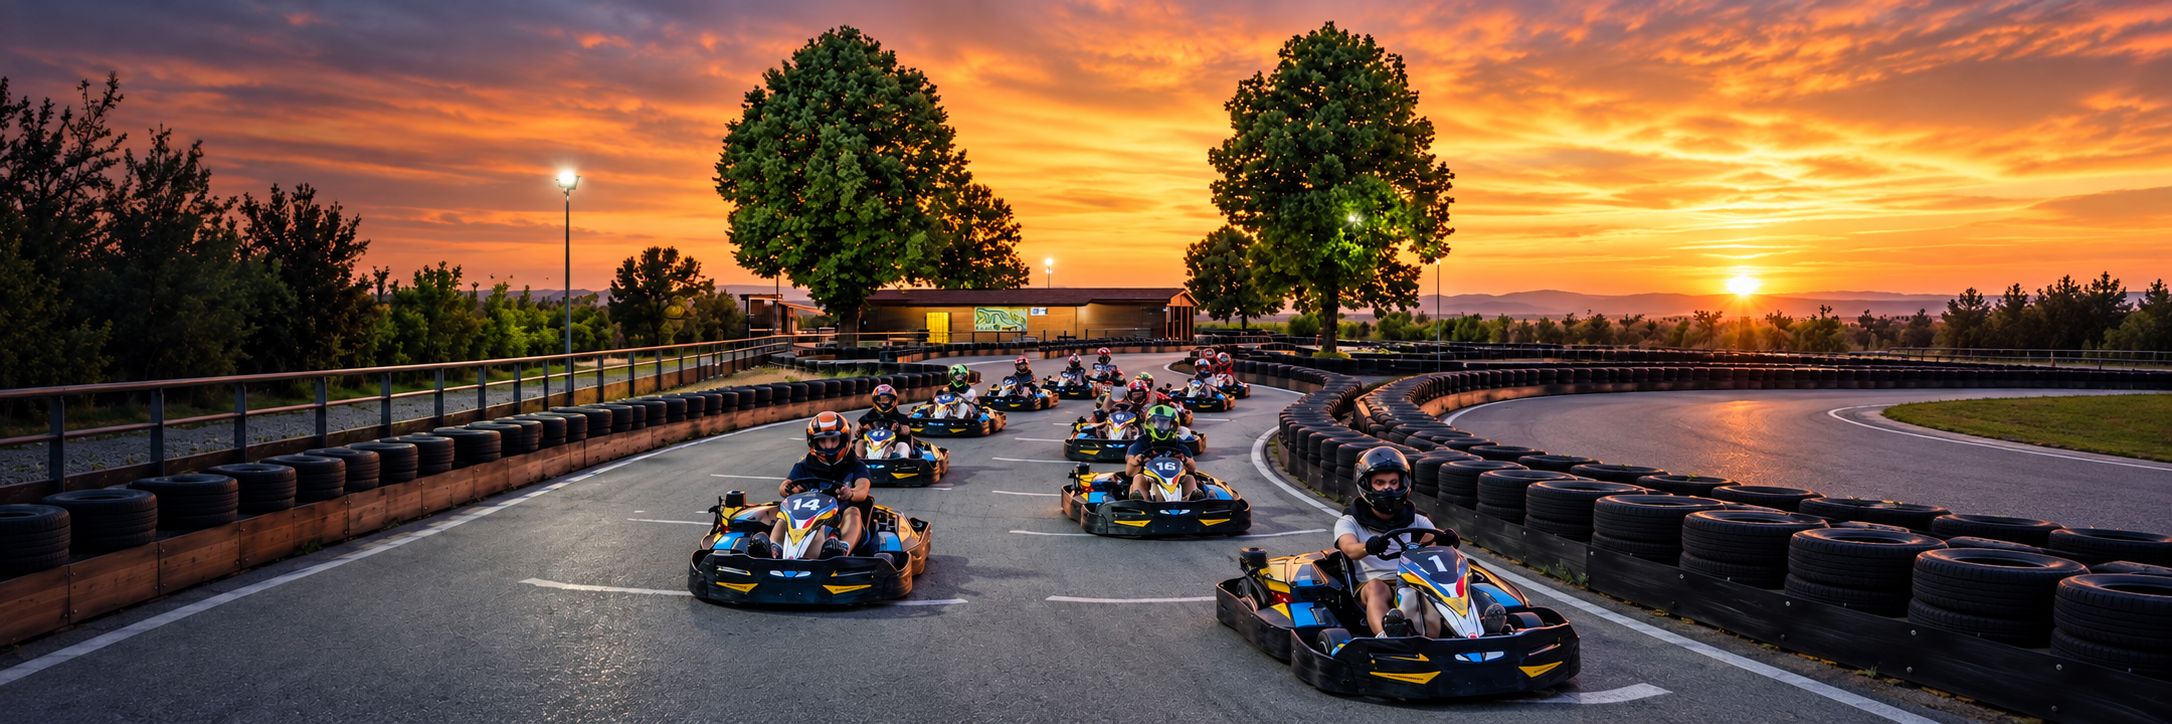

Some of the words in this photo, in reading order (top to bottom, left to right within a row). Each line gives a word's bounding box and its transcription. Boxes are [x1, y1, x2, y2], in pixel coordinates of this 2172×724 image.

[1155, 461, 1176, 471] 16
[793, 498, 820, 510] 14
[1428, 555, 1448, 572] 1
